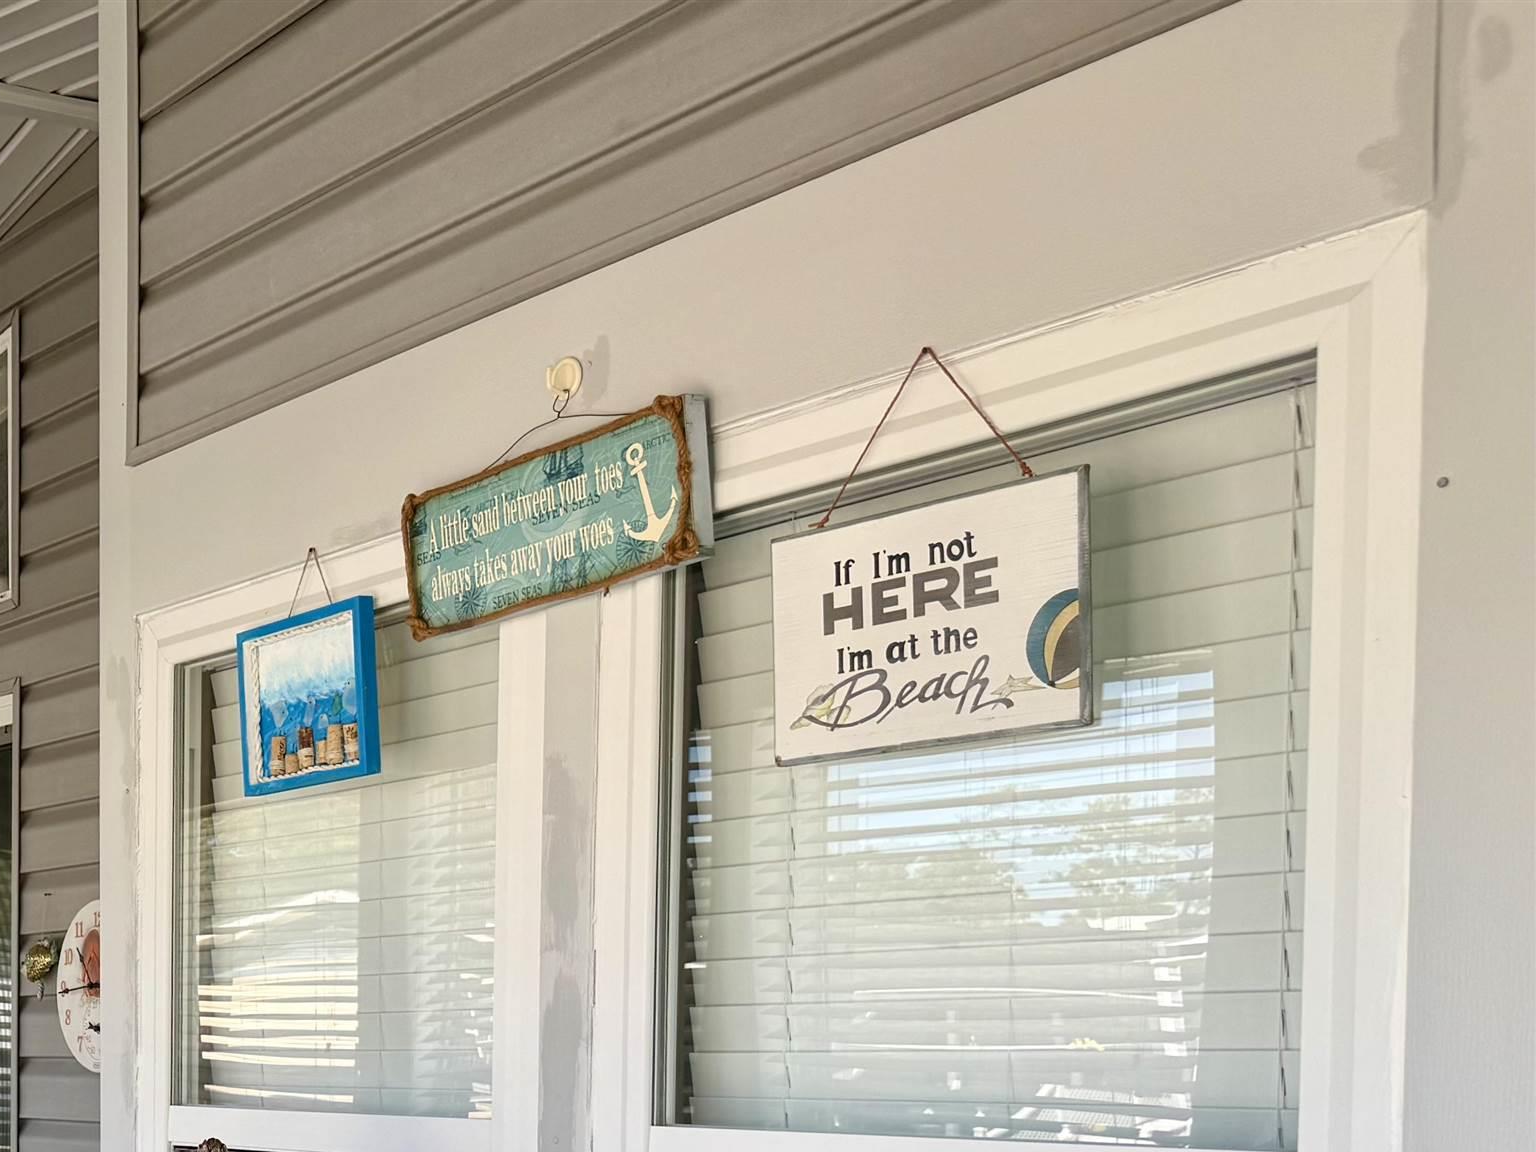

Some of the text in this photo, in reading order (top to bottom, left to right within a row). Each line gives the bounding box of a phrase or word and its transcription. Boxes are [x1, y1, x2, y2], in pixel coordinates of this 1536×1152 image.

[429, 461, 624, 554] A little sand between your toes
[572, 493, 601, 512] SEAS
[431, 517, 614, 602] always takes away your woes
[833, 531, 978, 588] If I'm not
[492, 582, 543, 610] SEVEN SEAS
[822, 556, 1000, 637] HERE
[836, 626, 979, 675] I'm at the
[801, 654, 1014, 732] Beach
[75, 921, 84, 938] 11
[64, 947, 73, 966] 10
[65, 1008, 72, 1026] 8
[77, 1035, 84, 1053] 7
